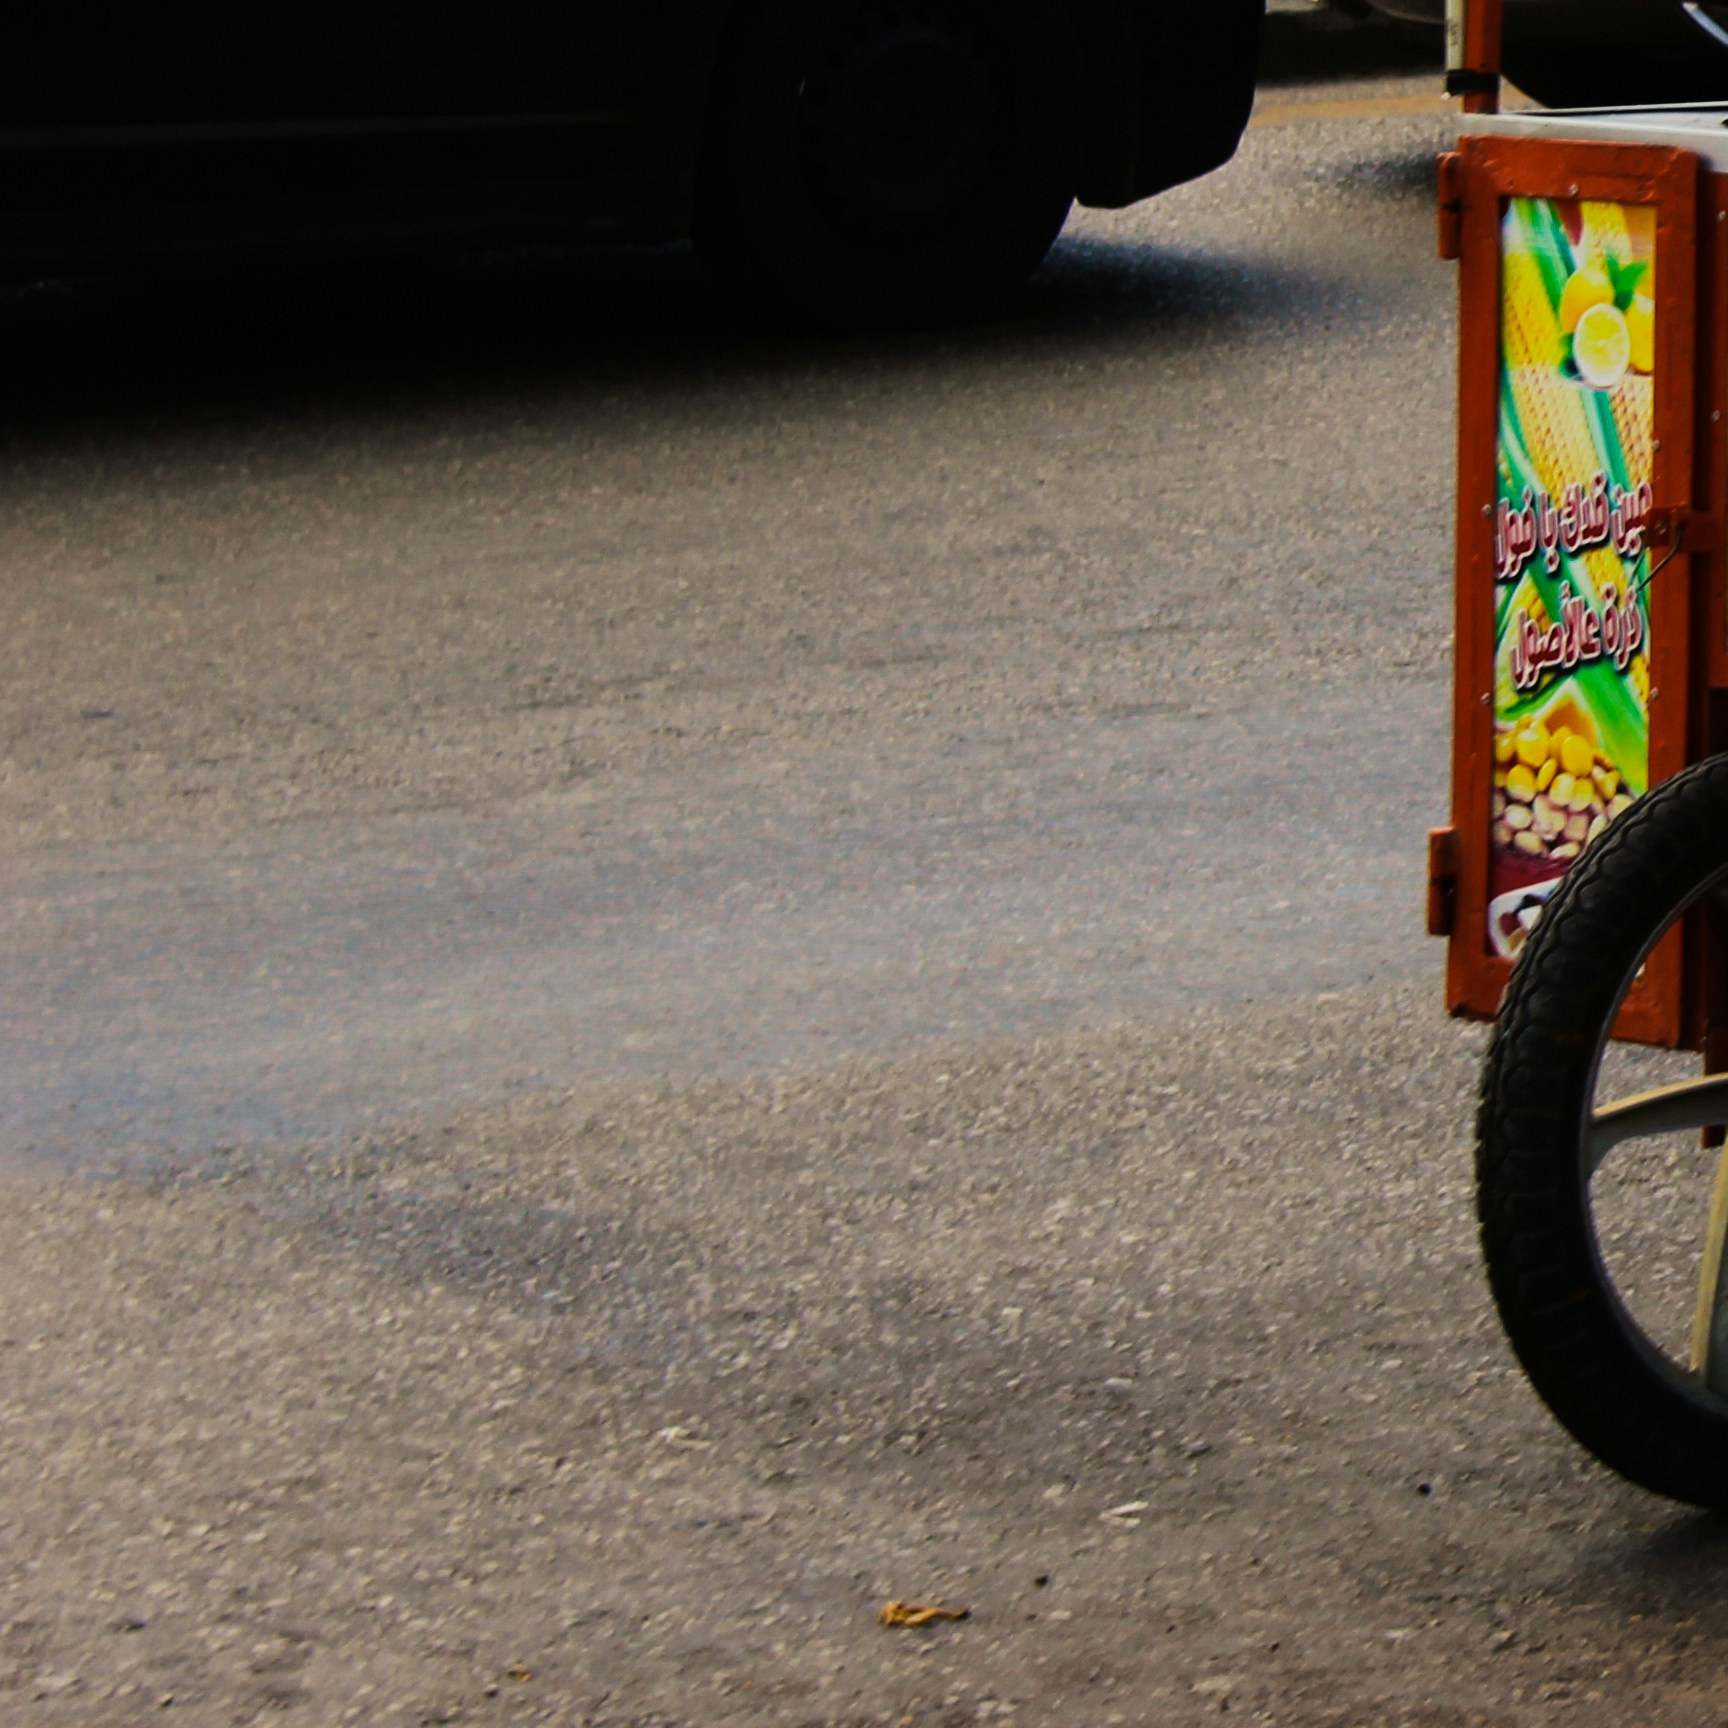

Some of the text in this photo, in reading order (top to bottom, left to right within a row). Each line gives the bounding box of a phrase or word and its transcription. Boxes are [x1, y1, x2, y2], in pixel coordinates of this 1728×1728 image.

[1495, 471, 1653, 578] مين قدك يا فول
[1510, 580, 1643, 690] ذرة عالأصول
